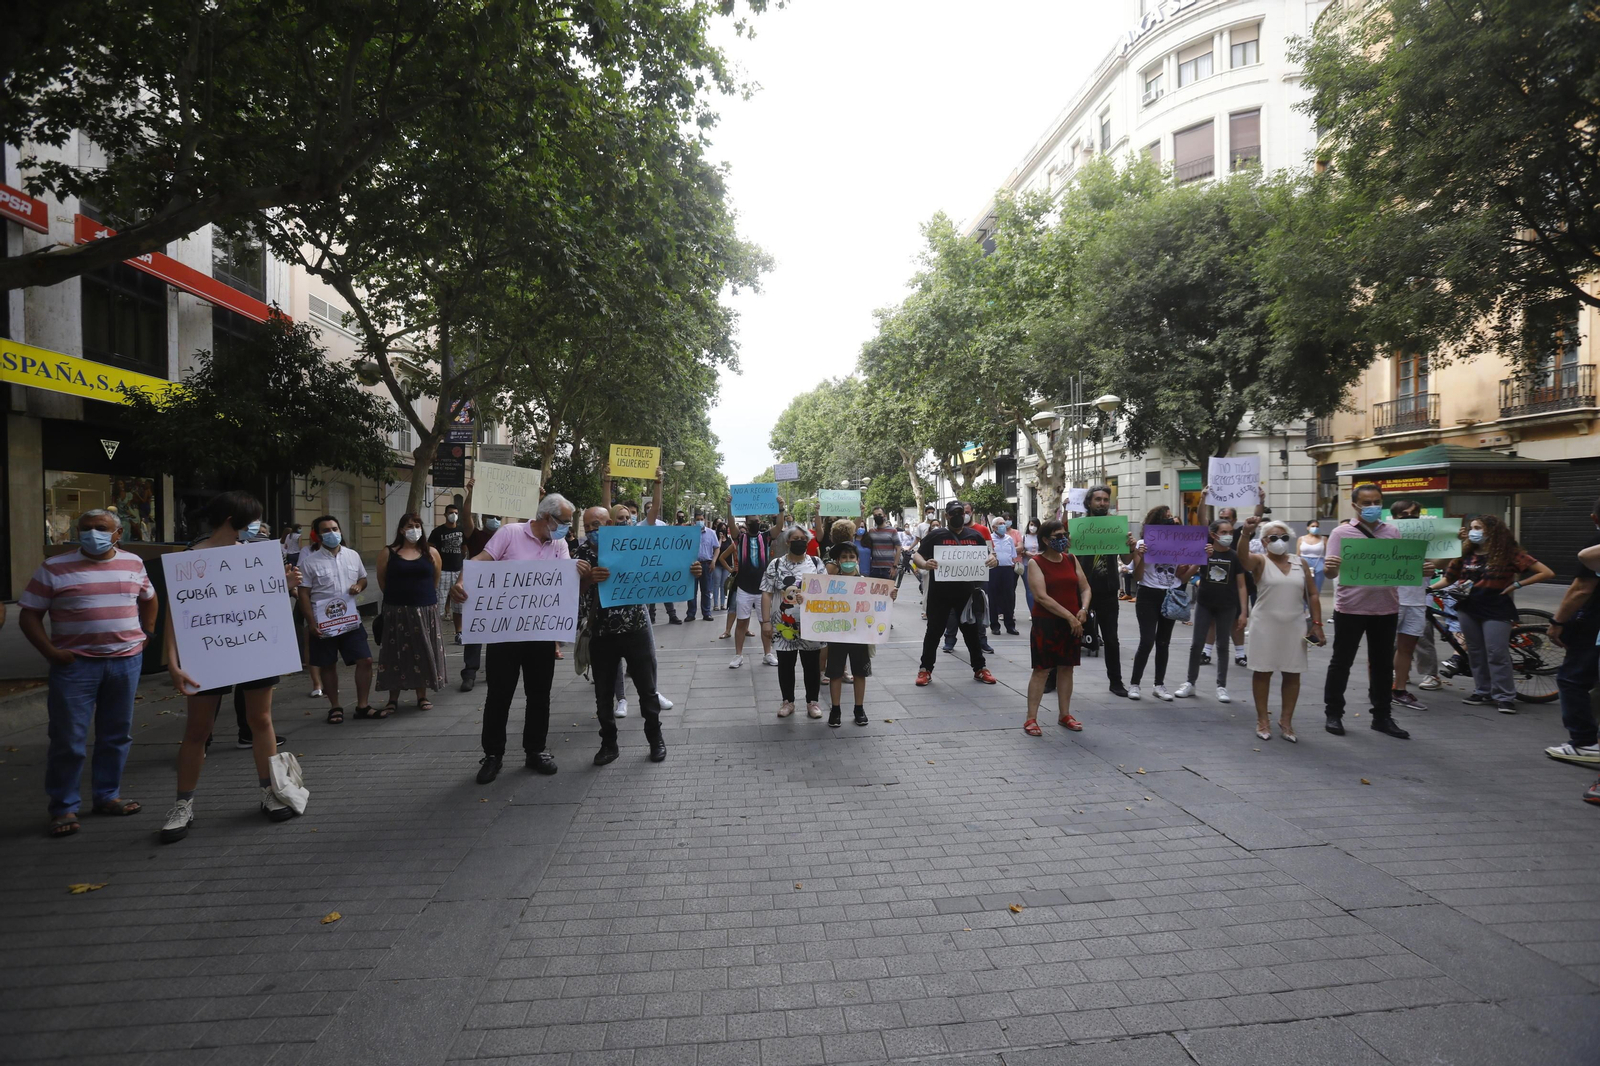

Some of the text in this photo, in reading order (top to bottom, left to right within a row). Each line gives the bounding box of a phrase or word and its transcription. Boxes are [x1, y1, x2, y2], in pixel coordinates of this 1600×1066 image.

[616, 457, 650, 469] USURERAS
[480, 466, 517, 482] FACTURA
[526, 473, 540, 486] LUZ
[488, 481, 527, 497] EMBROLLO
[485, 494, 522, 512] Y TIMO
[1076, 521, 1123, 540] Gobiernos
[1397, 520, 1436, 533] BAJADA
[611, 533, 693, 552] REGULACIÓN
[1147, 529, 1173, 541] STOP
[1402, 532, 1436, 541] PRECIO
[219, 560, 231, 572] A
[244, 556, 264, 569] LA
[640, 554, 663, 567] DEL
[477, 568, 563, 589] LA ENERGÍA
[613, 571, 682, 584] MERCADO
[937, 565, 986, 578] ABUSONAS
[1363, 569, 1416, 584] asequibles
[225, 585, 238, 596] DE
[244, 584, 255, 592] LA
[611, 583, 687, 601] ELÉCTRICO
[827, 579, 848, 595] LUZ
[854, 581, 867, 595] ES
[474, 592, 560, 611] ELÉCTRICA
[854, 601, 871, 613] NO
[874, 600, 887, 612] UN
[469, 614, 574, 633] ES UN DERECHO
